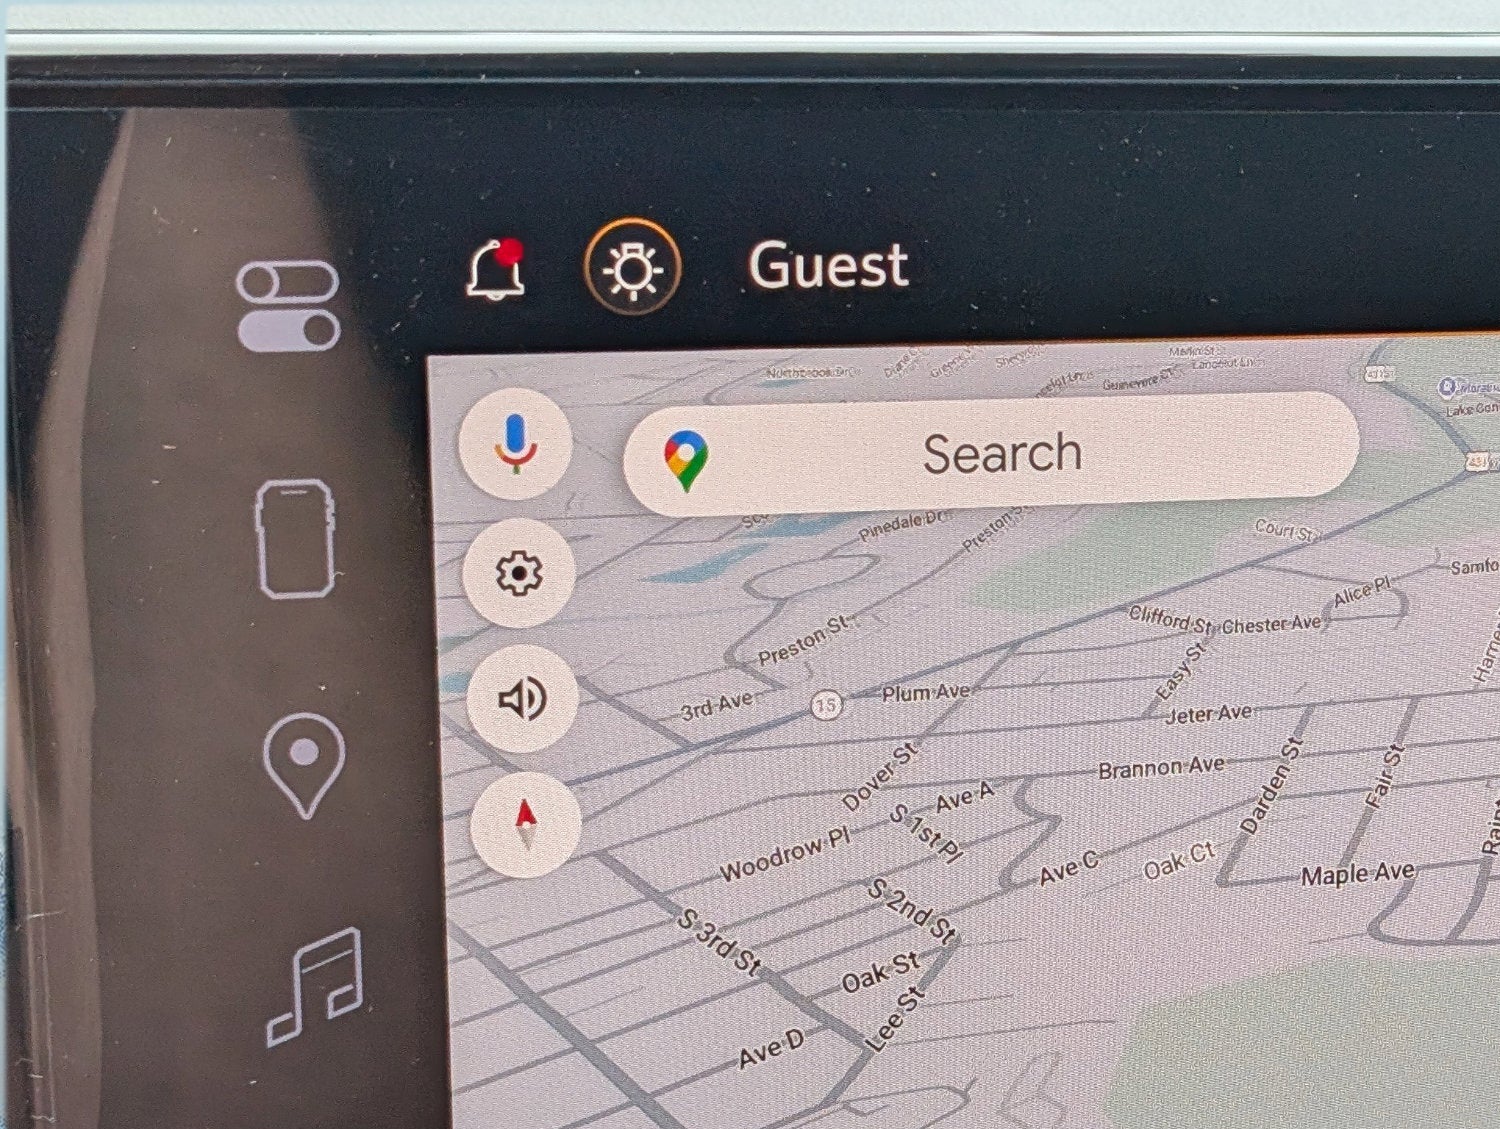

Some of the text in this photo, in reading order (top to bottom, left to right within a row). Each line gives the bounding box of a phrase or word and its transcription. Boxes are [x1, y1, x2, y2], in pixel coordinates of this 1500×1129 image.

[749, 240, 910, 289] Guest
[1446, 403, 1473, 418] Lake
[924, 431, 1082, 474] Search
[858, 513, 921, 542] Pinedale
[962, 511, 1012, 553] Preston
[1255, 518, 1319, 543] Court St
[1334, 575, 1391, 609] Alice Pl
[758, 613, 849, 666] Preston St
[1129, 604, 1212, 635] Clifford St
[1223, 614, 1322, 635] Chester Ave
[1156, 641, 1208, 701] Easy St
[680, 691, 754, 723] 3rd Ave
[883, 682, 970, 703] Plum Ave
[1166, 704, 1252, 725] Jeter Ave
[842, 741, 919, 812] Dover St
[1099, 755, 1225, 780] Brannon Ave
[1239, 736, 1304, 836] Darden St
[1365, 743, 1406, 809] Fair St
[935, 780, 995, 814] Ave A
[719, 825, 851, 883] Woodrow Pl
[889, 803, 964, 865] S 1st Pl
[1040, 850, 1099, 887] Ave C
[1144, 841, 1216, 881] Oak Ct
[1301, 862, 1415, 889] Maple Ave
[868, 877, 957, 945] S 2nd St
[678, 907, 762, 977] S 3rd St
[842, 951, 921, 994] Oak St
[865, 985, 925, 1053] Lee St
[739, 1028, 805, 1070] Ave D
